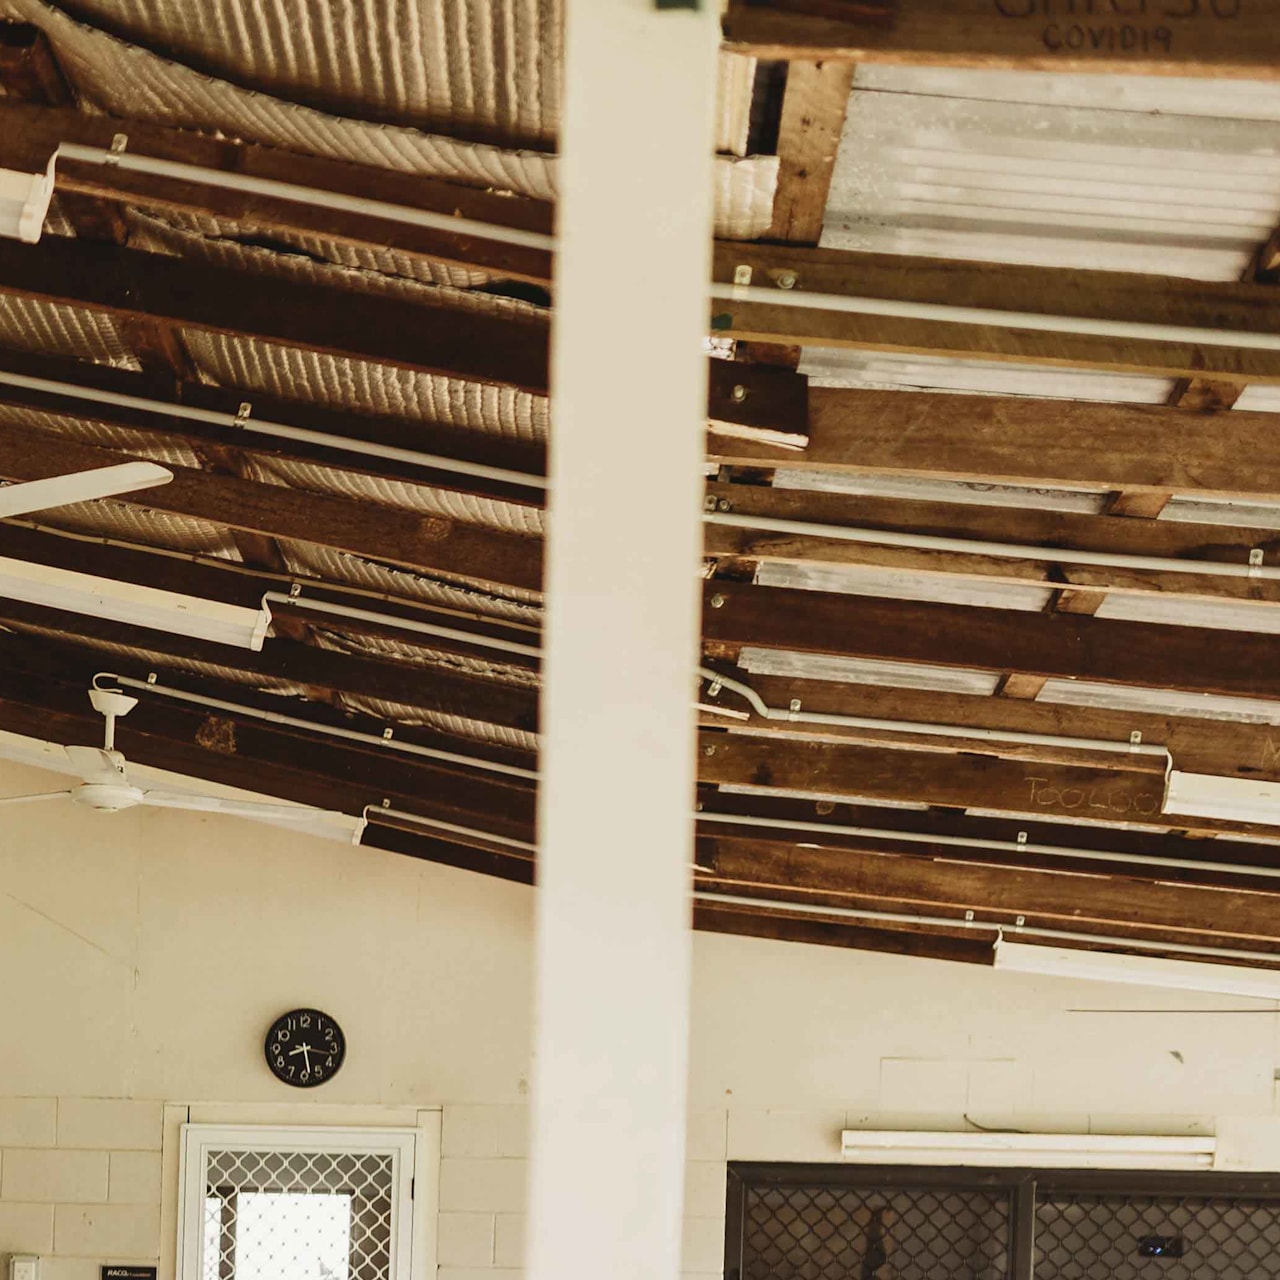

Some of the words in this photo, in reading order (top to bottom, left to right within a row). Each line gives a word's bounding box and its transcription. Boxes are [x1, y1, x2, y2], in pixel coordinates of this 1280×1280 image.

[287, 1017, 296, 1031] 11
[300, 1015, 311, 1028] 12
[277, 1030, 290, 1042] 10
[325, 1028, 334, 1041] 2
[272, 1043, 281, 1055] 9
[330, 1041, 338, 1054] 3
[276, 1055, 285, 1067] 8
[325, 1055, 332, 1067] 4
[288, 1065, 295, 1077] 7
[300, 1068, 309, 1080] 6
[314, 1065, 322, 1077] 5
